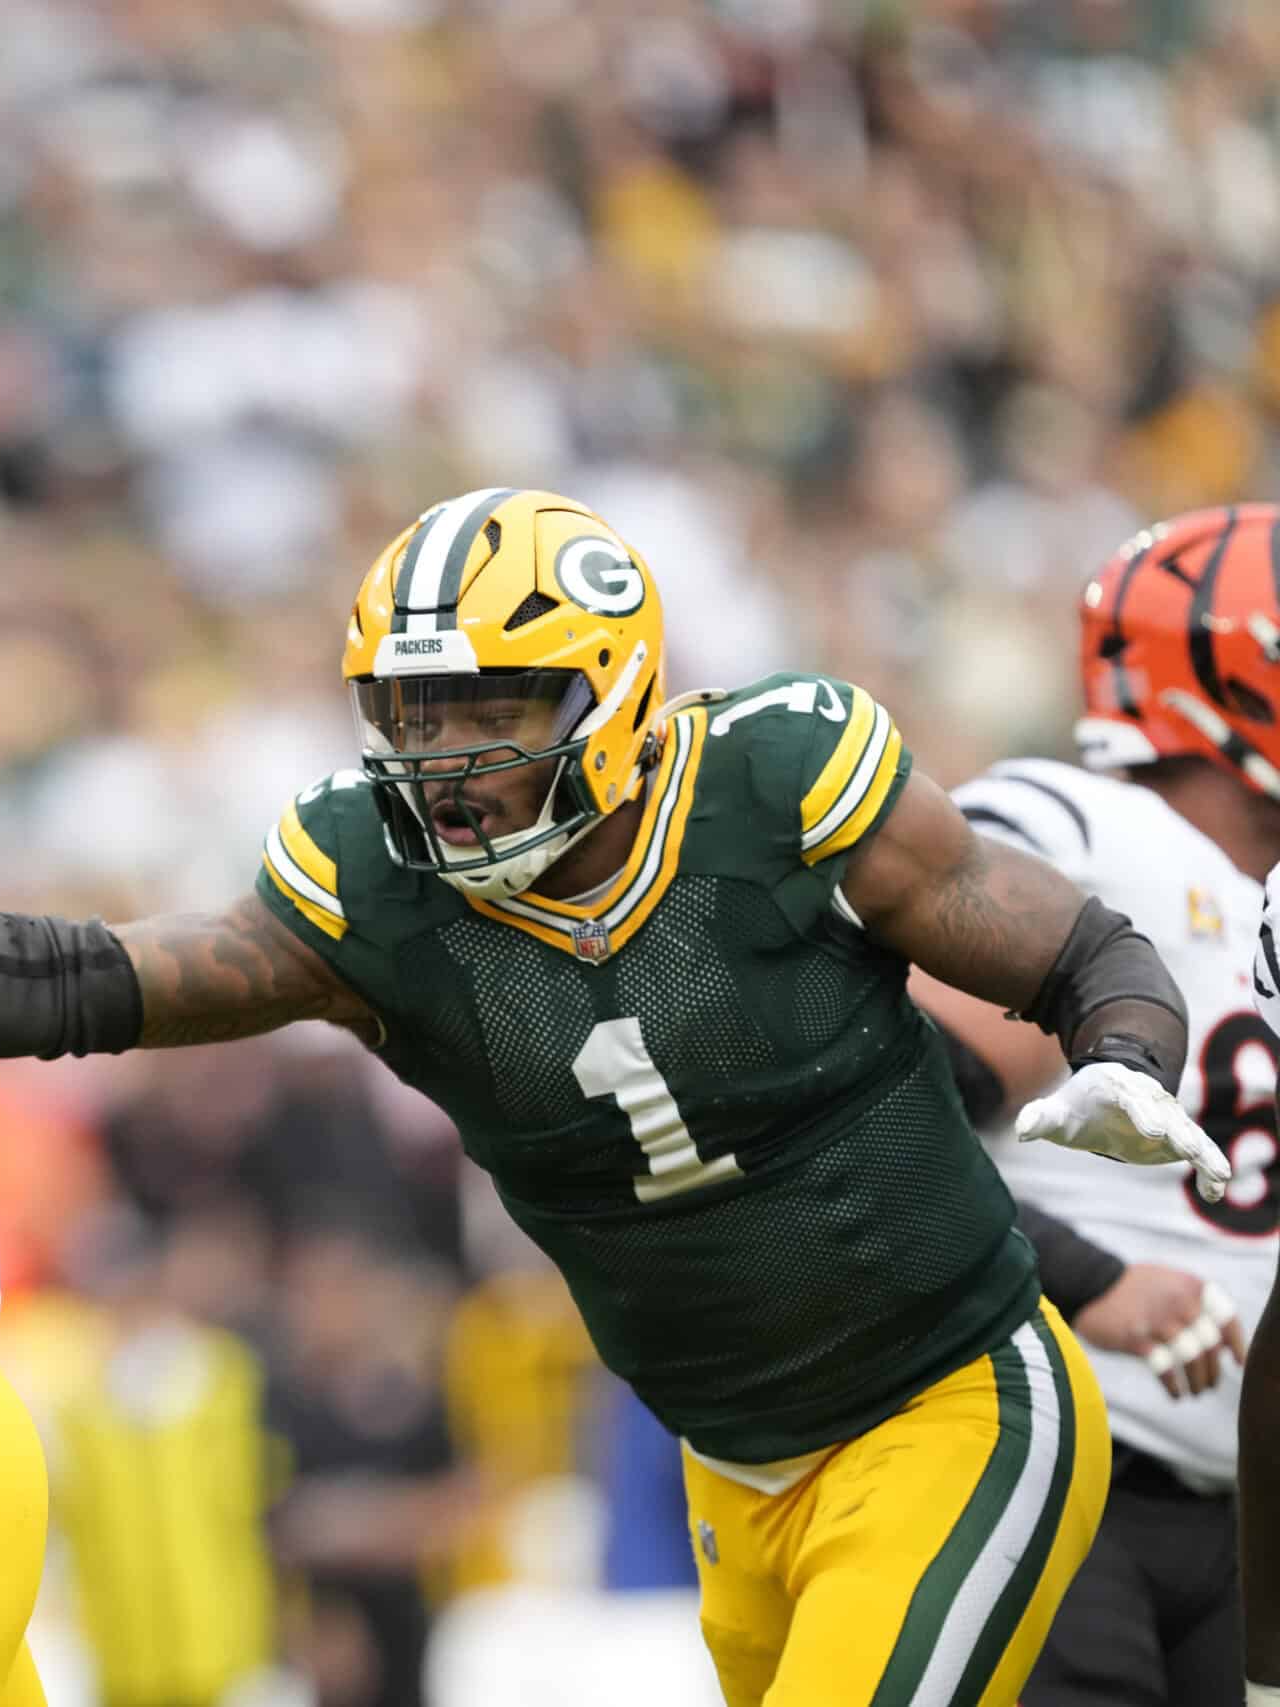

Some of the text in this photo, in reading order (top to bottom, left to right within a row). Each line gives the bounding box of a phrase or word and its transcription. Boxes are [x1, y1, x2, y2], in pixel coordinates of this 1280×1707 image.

[559, 539, 644, 612] G
[394, 638, 443, 656] PACKERS
[571, 1015, 746, 1203] 1
